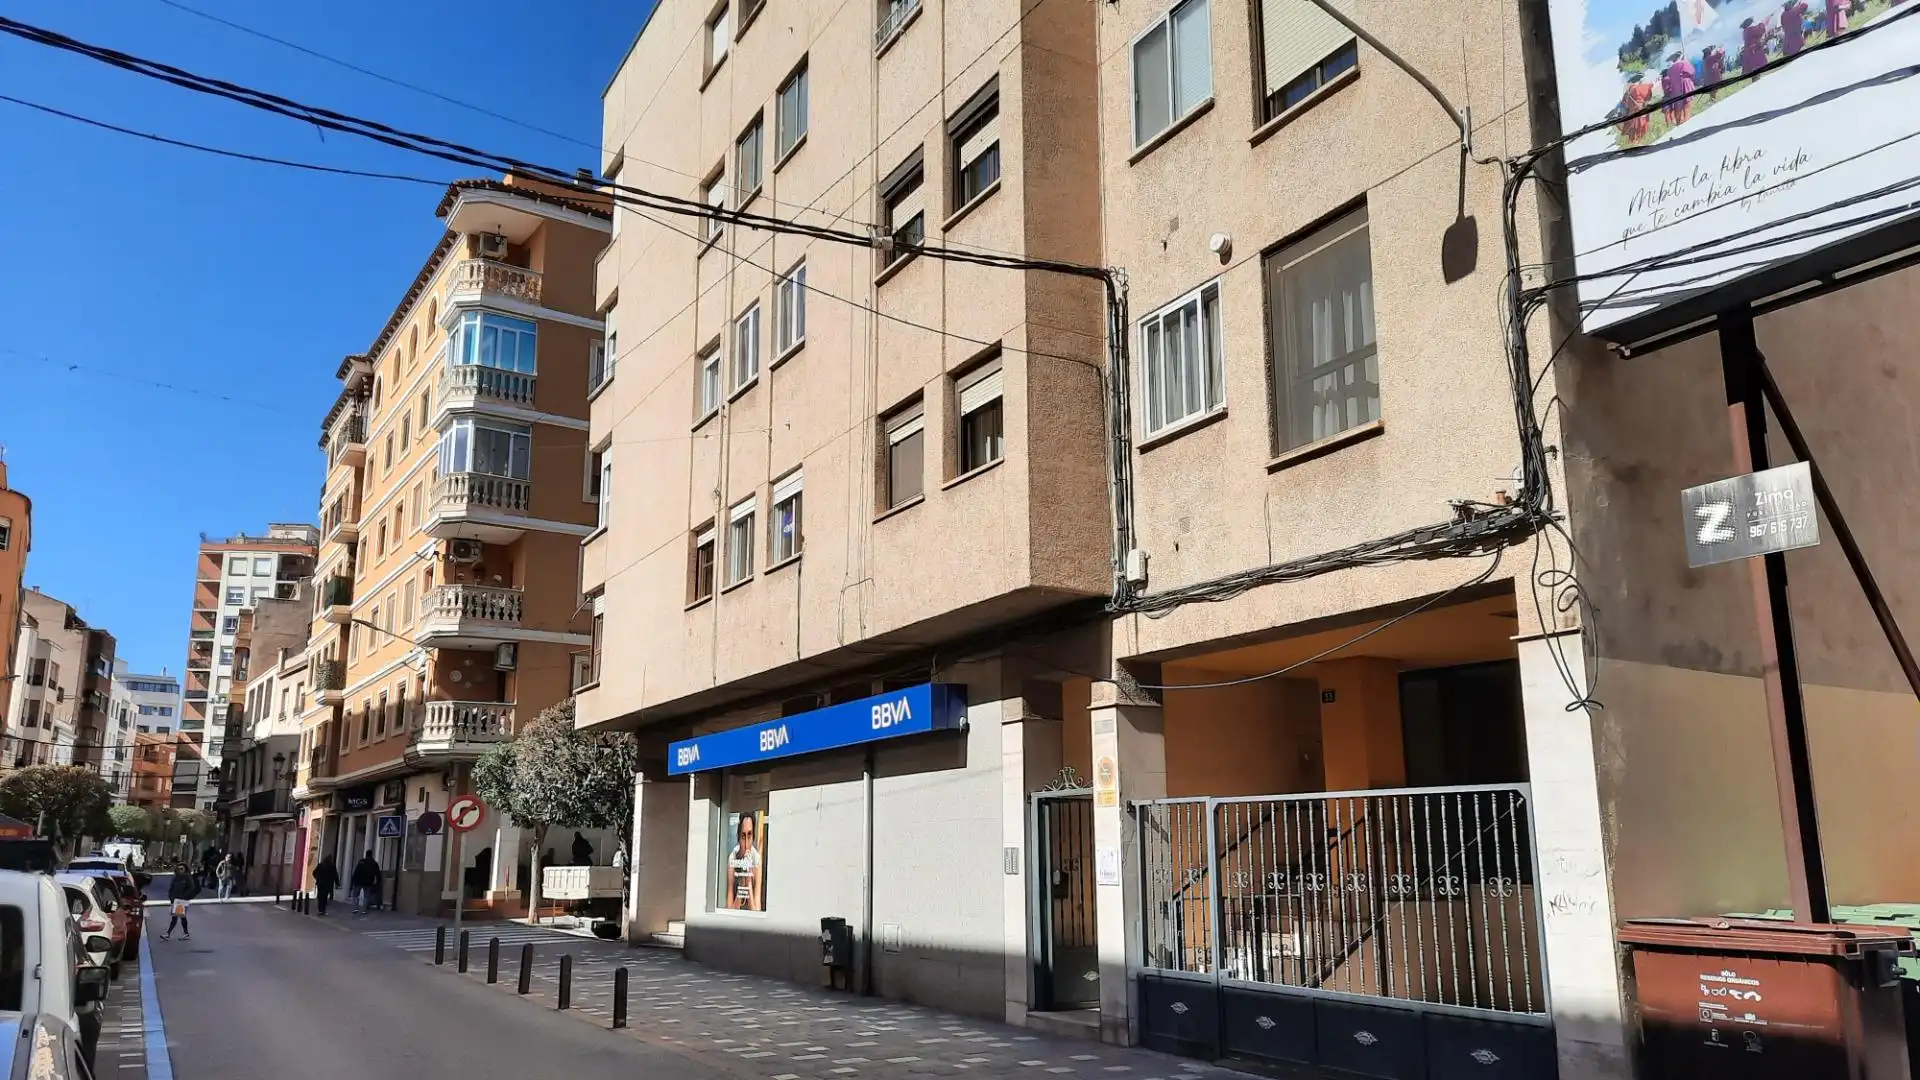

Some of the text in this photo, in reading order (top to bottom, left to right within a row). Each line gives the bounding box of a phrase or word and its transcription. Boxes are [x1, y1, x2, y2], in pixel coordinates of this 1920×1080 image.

[1692, 164, 1712, 188] la
[1718, 145, 1766, 181] fibra
[1622, 146, 1812, 250] que te cambia la vida
[1749, 523, 1768, 538] 967
[871, 696, 912, 730] BBVA
[759, 724, 789, 752] BBVA
[677, 743, 700, 767] BBVA
